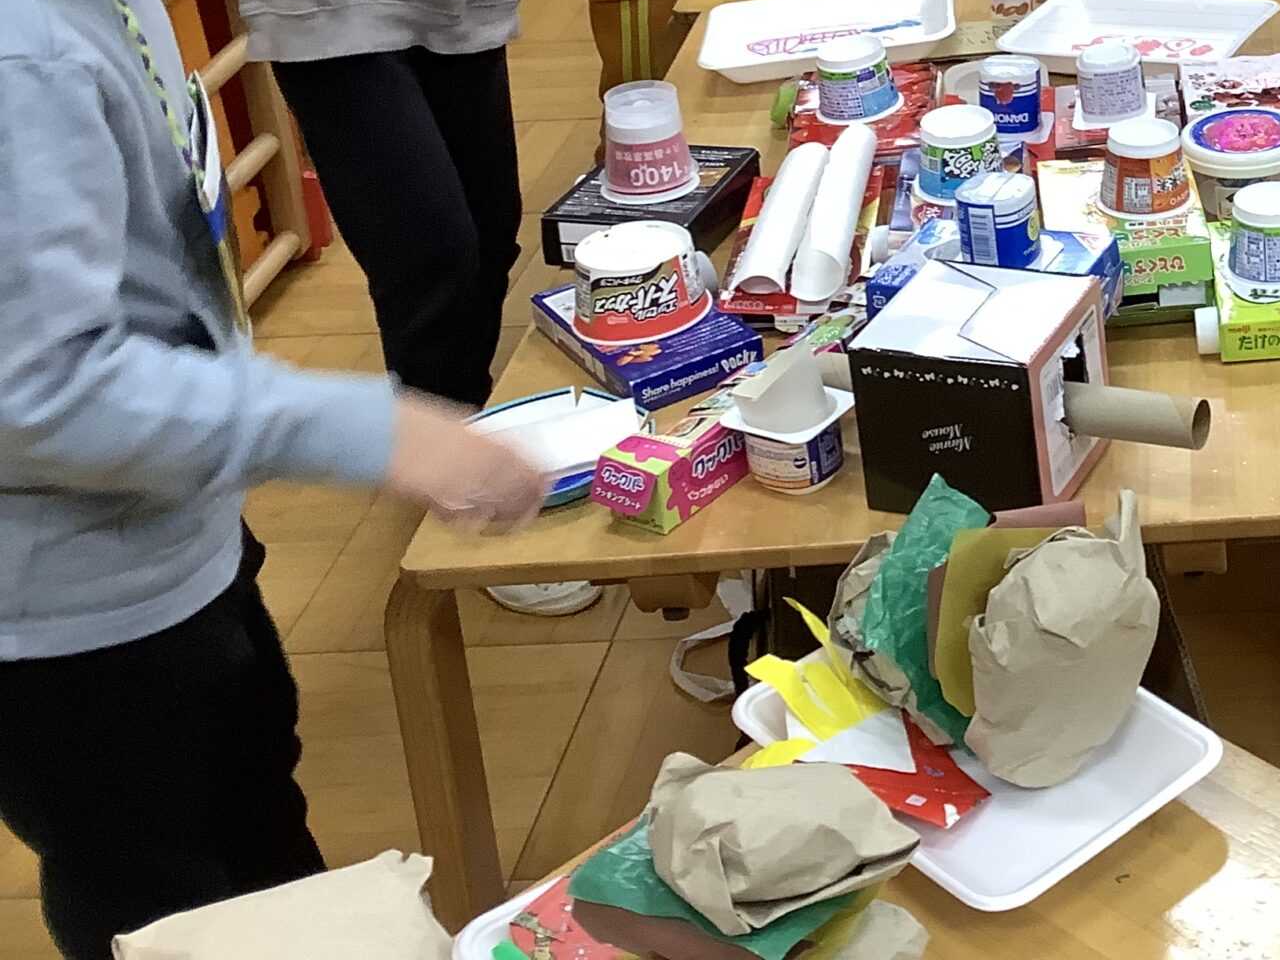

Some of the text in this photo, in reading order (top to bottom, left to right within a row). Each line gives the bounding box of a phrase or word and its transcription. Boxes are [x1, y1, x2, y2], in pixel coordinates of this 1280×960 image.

[594, 273, 679, 313] スーパーカップ
[642, 384, 670, 400] Share
[670, 363, 720, 387] happiness!
[922, 423, 964, 440] Mouse
[928, 435, 973, 455] Minnie
